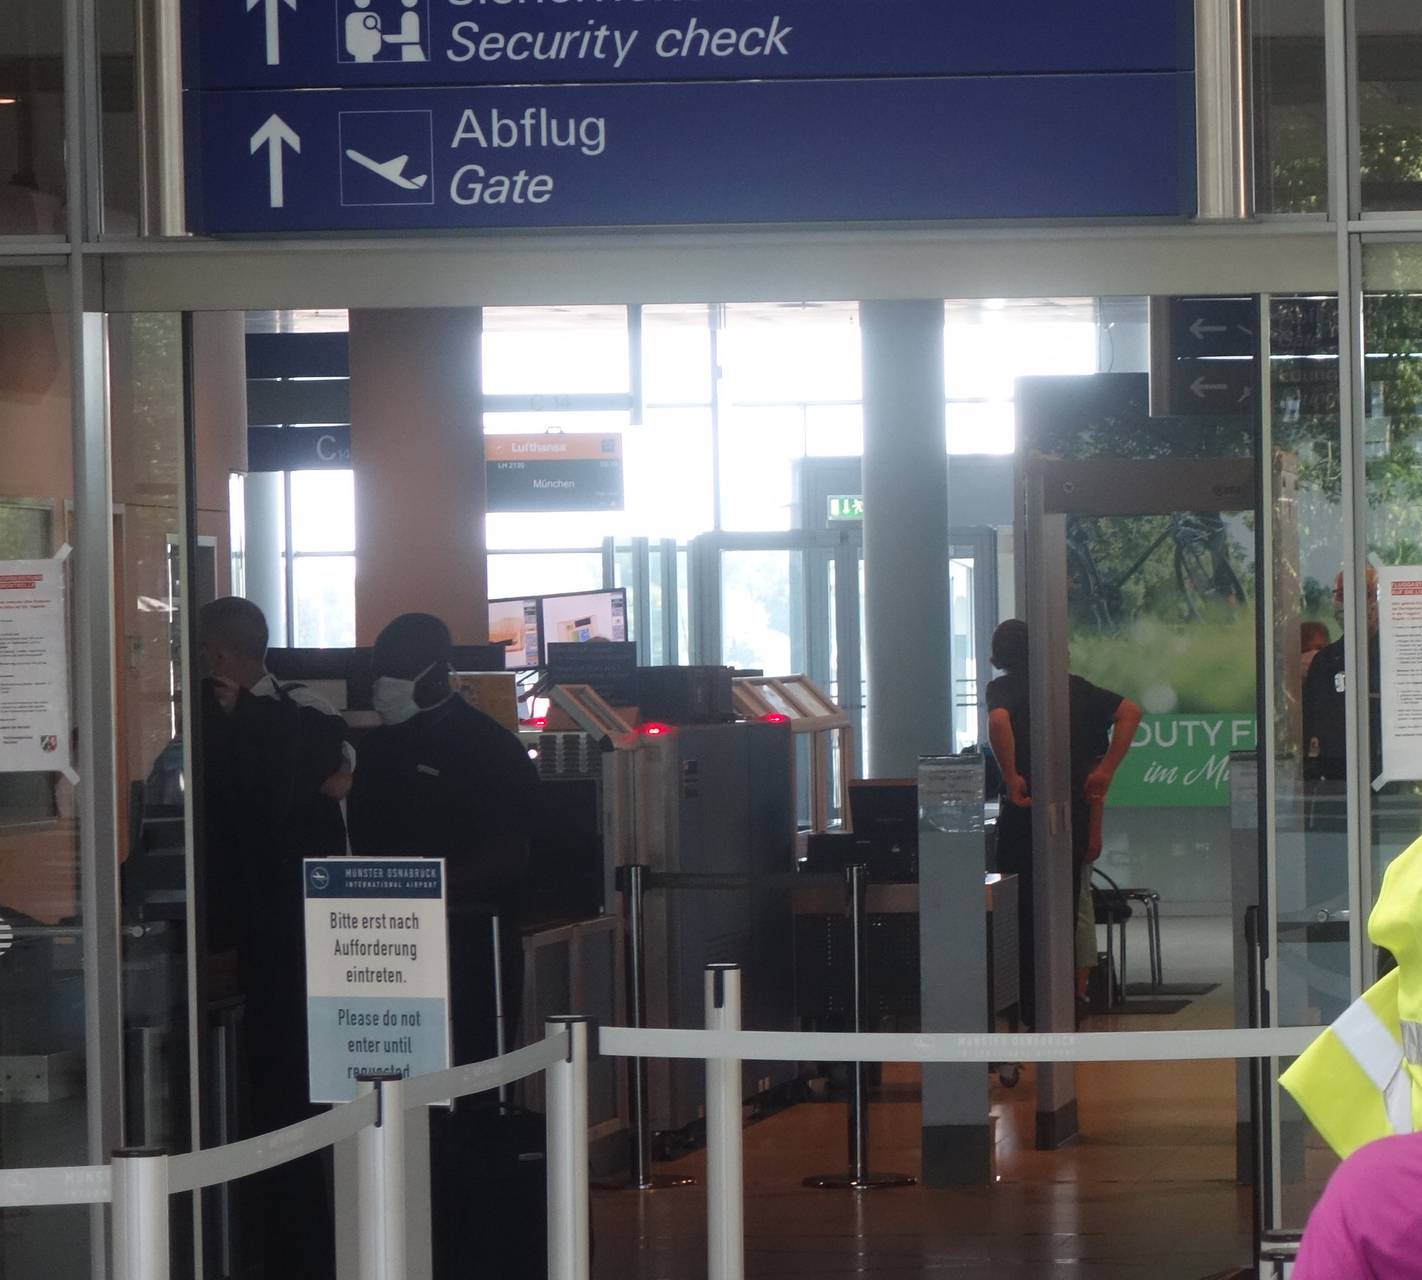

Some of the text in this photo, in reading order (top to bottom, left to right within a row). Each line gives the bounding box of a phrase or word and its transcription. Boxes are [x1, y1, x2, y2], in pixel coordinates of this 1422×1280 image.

[446, 15, 792, 68] Security check
[451, 108, 606, 155] Abflug
[450, 164, 553, 205] Gate
[511, 442, 567, 452] Lufthansa
[533, 479, 575, 489] München
[1130, 719, 1223, 748] DUTY
[1144, 761, 1179, 785] im
[330, 912, 419, 929] Bitte erst nach
[334, 939, 417, 961] Aufforderung
[346, 967, 407, 983] eintreten.
[338, 1009, 421, 1027] Please do not
[348, 1036, 412, 1053] enter until
